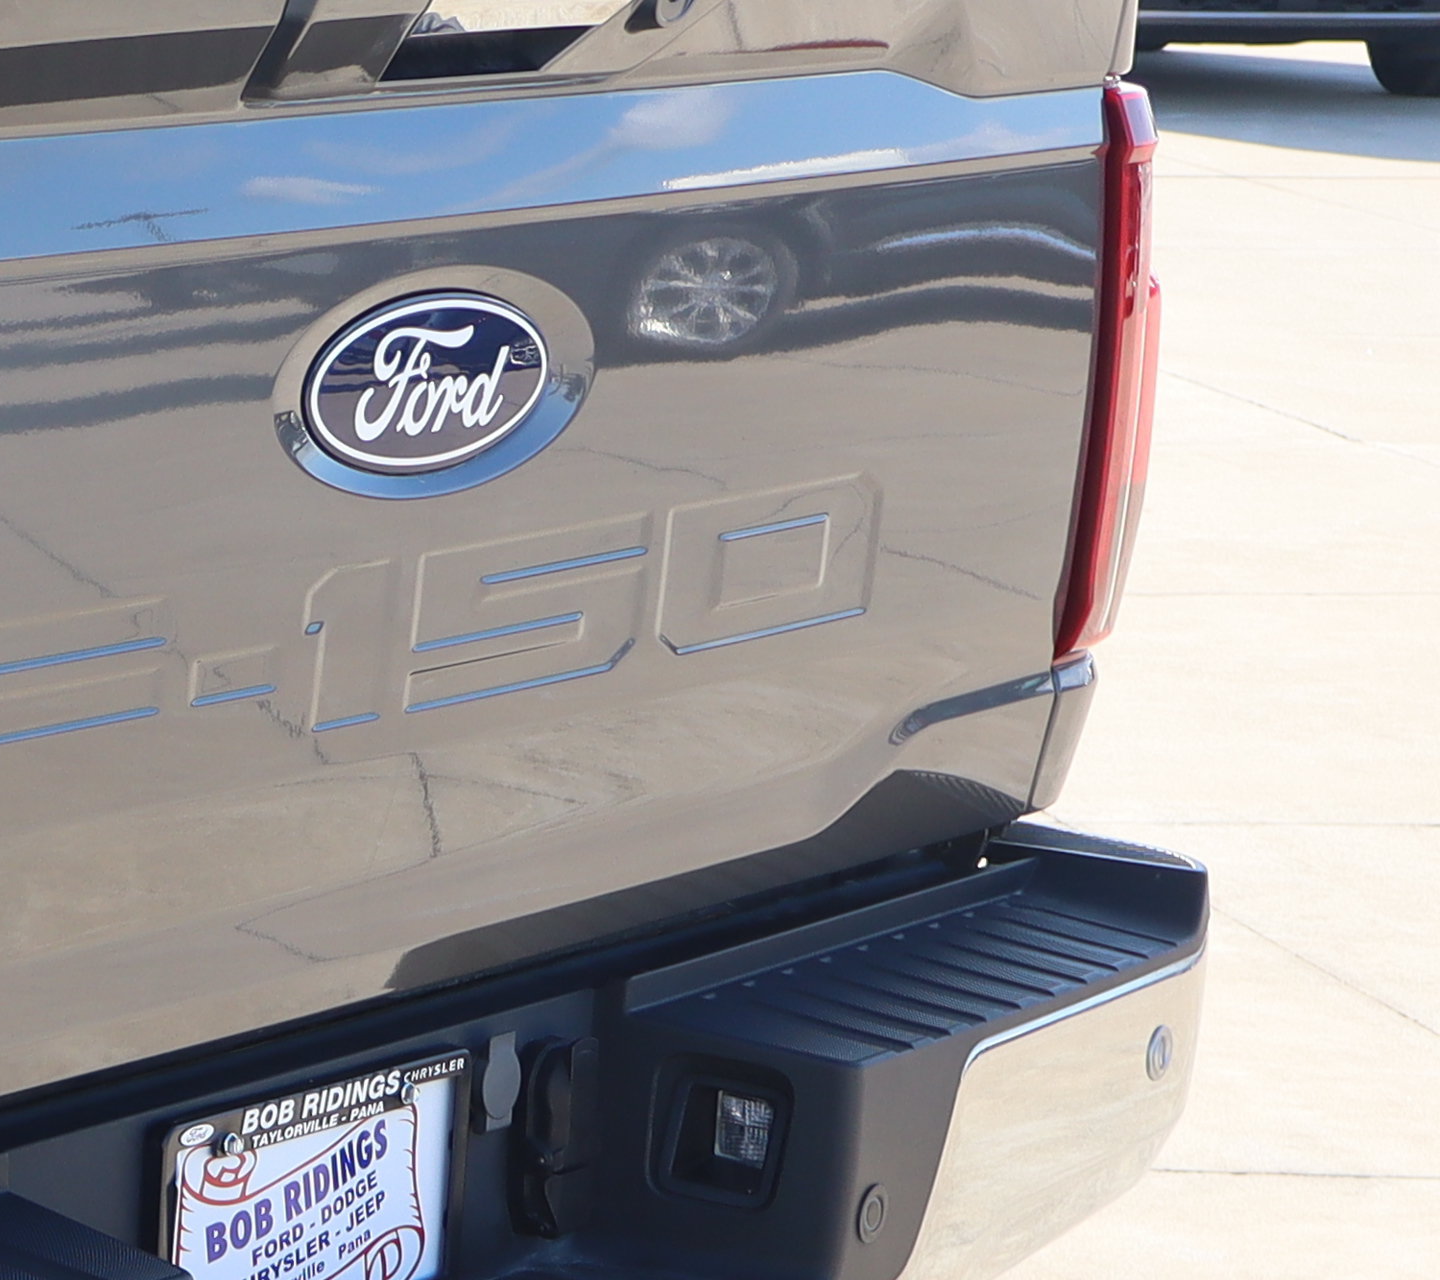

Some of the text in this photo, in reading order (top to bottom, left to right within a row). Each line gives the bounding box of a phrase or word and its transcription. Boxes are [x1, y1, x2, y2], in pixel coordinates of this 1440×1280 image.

[354, 324, 510, 441] Ford
[242, 1058, 464, 1135] BOB RIDINGS CHRYSLER
[251, 1114, 338, 1149] TAYLORVILLE
[349, 1101, 384, 1122] PANA
[205, 1119, 388, 1264] BOB RIDINGS
[251, 1223, 304, 1267] FORD
[321, 1170, 378, 1226] DODGE
[346, 1190, 386, 1233] JEEP
[338, 1229, 371, 1260] Pana
